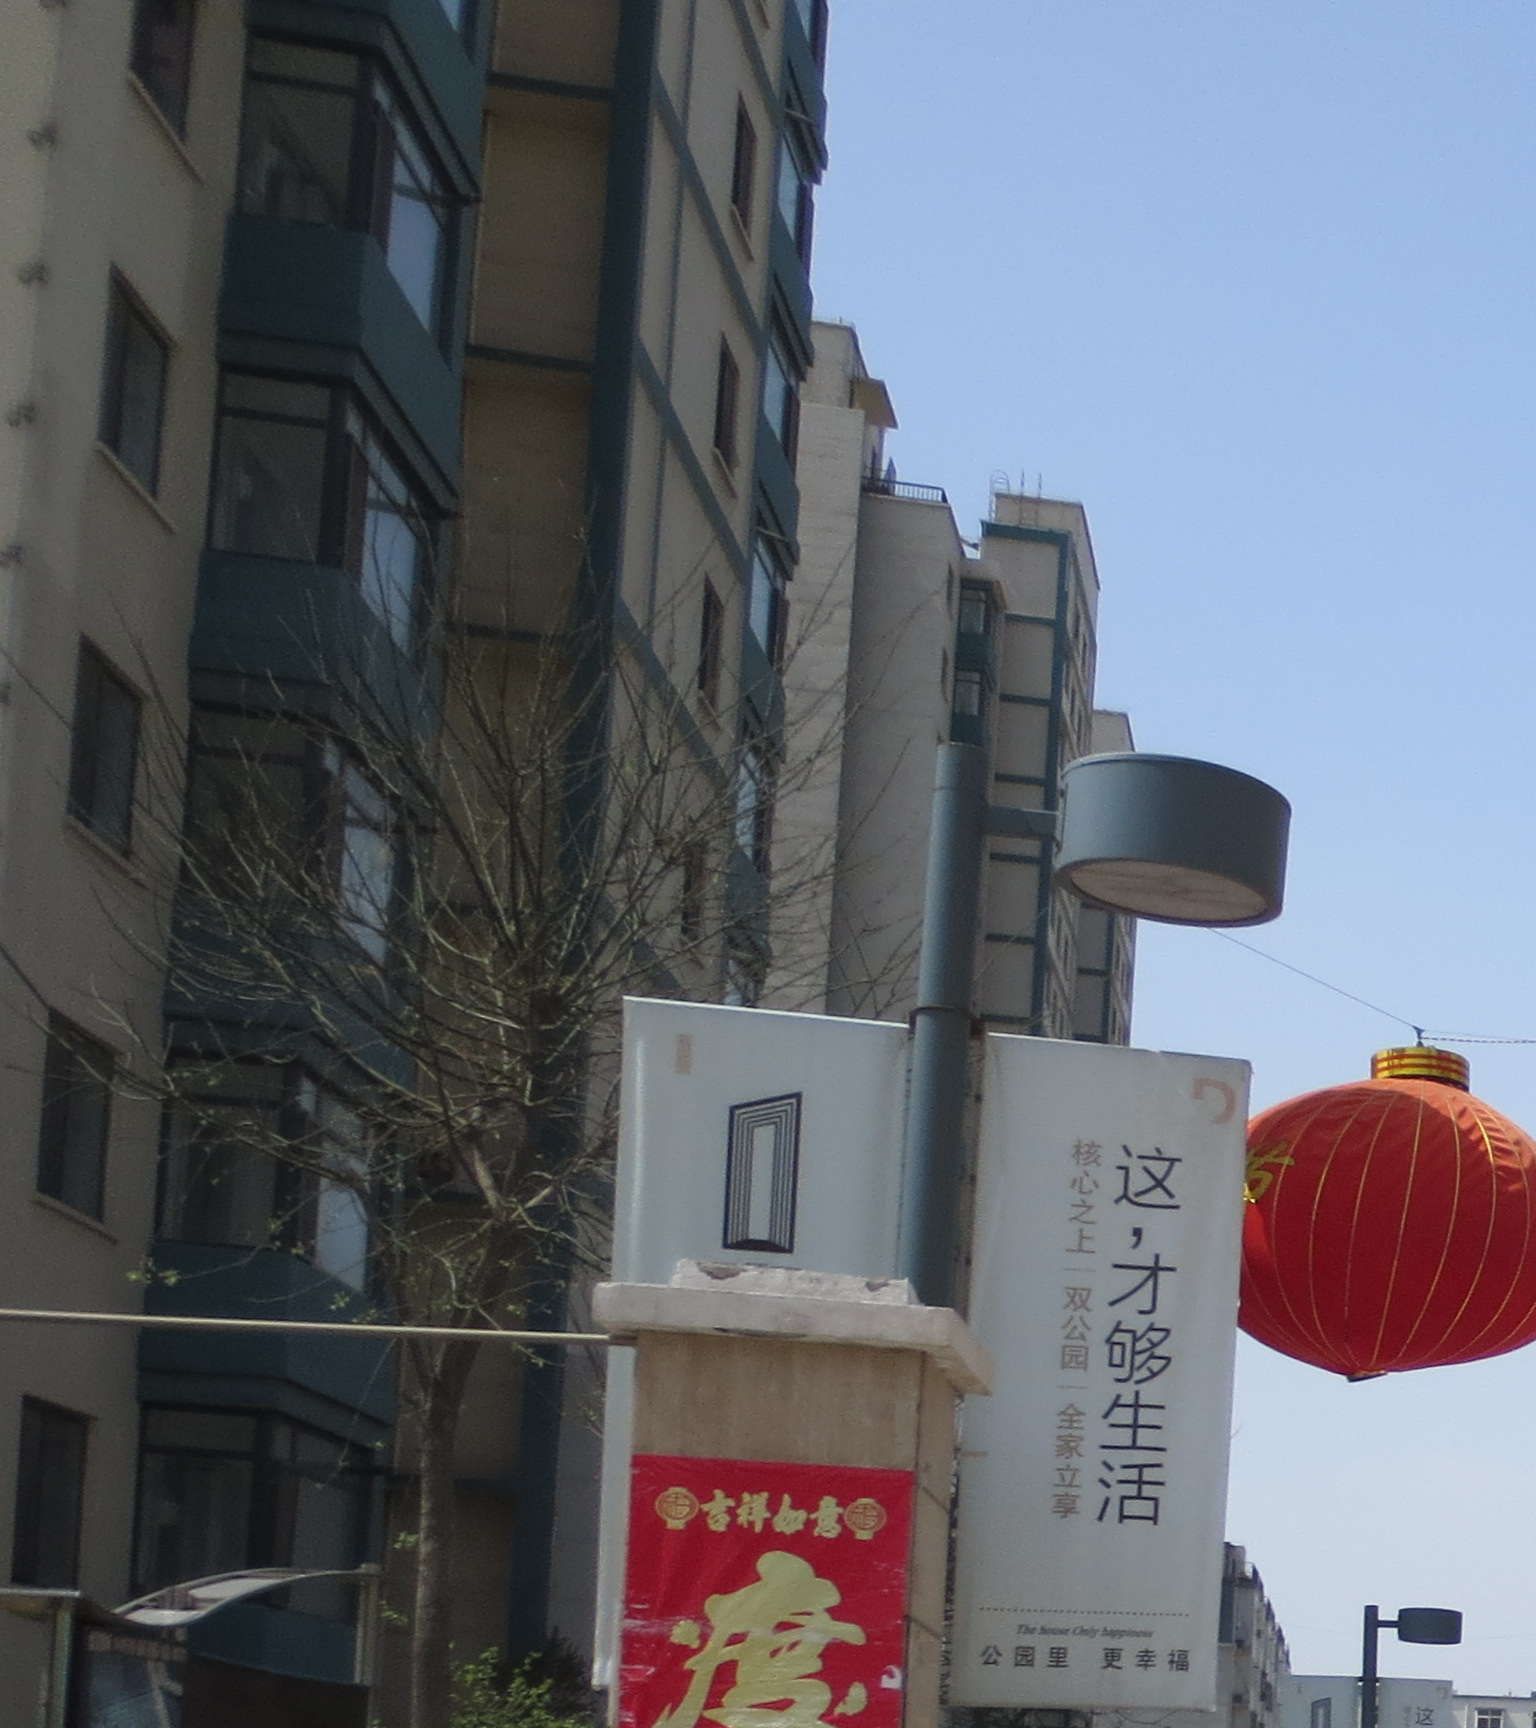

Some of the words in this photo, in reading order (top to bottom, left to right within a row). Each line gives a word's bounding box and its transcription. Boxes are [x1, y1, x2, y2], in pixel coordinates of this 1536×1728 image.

[699, 1488, 844, 1539] 吉祥如意
[979, 1645, 1070, 1669] 公园里
[1100, 1648, 1191, 1673] 更幸福
